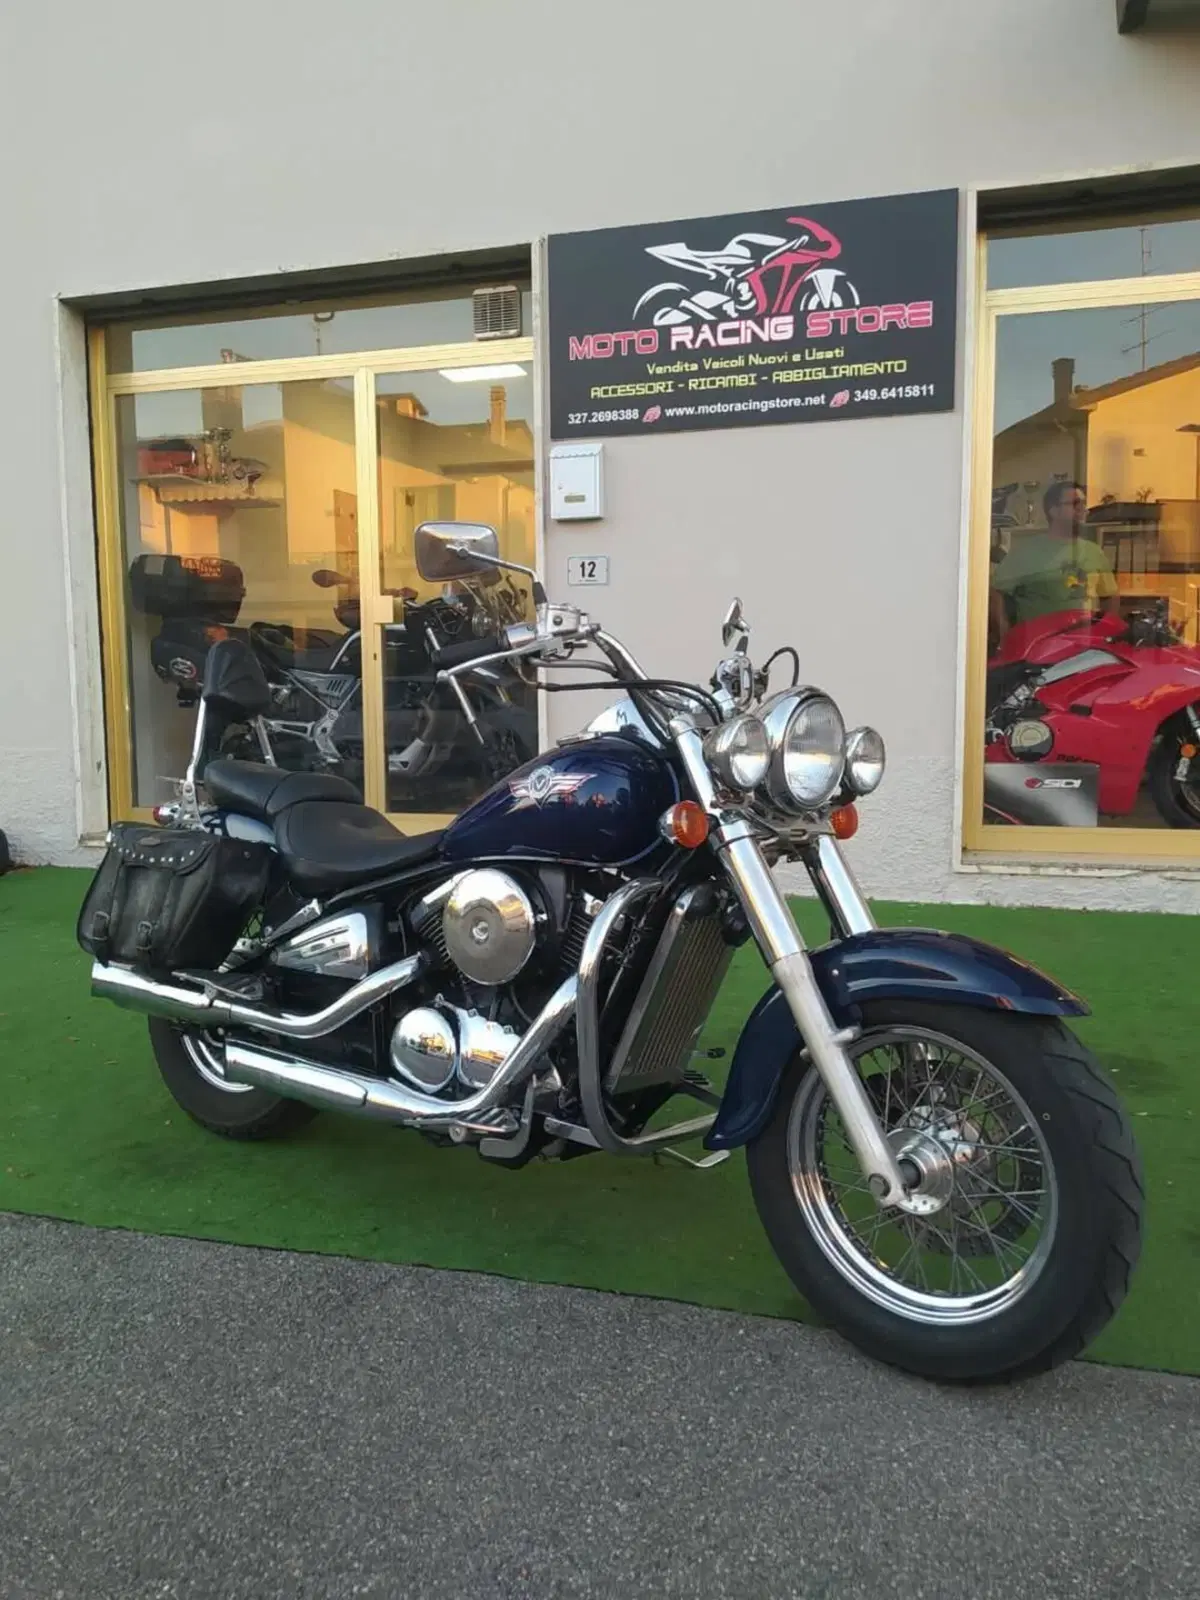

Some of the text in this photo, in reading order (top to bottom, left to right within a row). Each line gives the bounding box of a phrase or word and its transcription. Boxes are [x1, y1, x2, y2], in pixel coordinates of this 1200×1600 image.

[569, 301, 934, 361] MOTO RACING STORE
[590, 380, 675, 400] ACCESSORI
[688, 373, 757, 391] RICAMBI
[772, 359, 908, 384] ABBIGLIAMENTO
[646, 346, 845, 376] Vendita Veicoli Nuovi e Usati
[568, 383, 935, 425] 327.2698388 www.motoracingstore.net 349.6415811
[580, 560, 597, 578] 12
